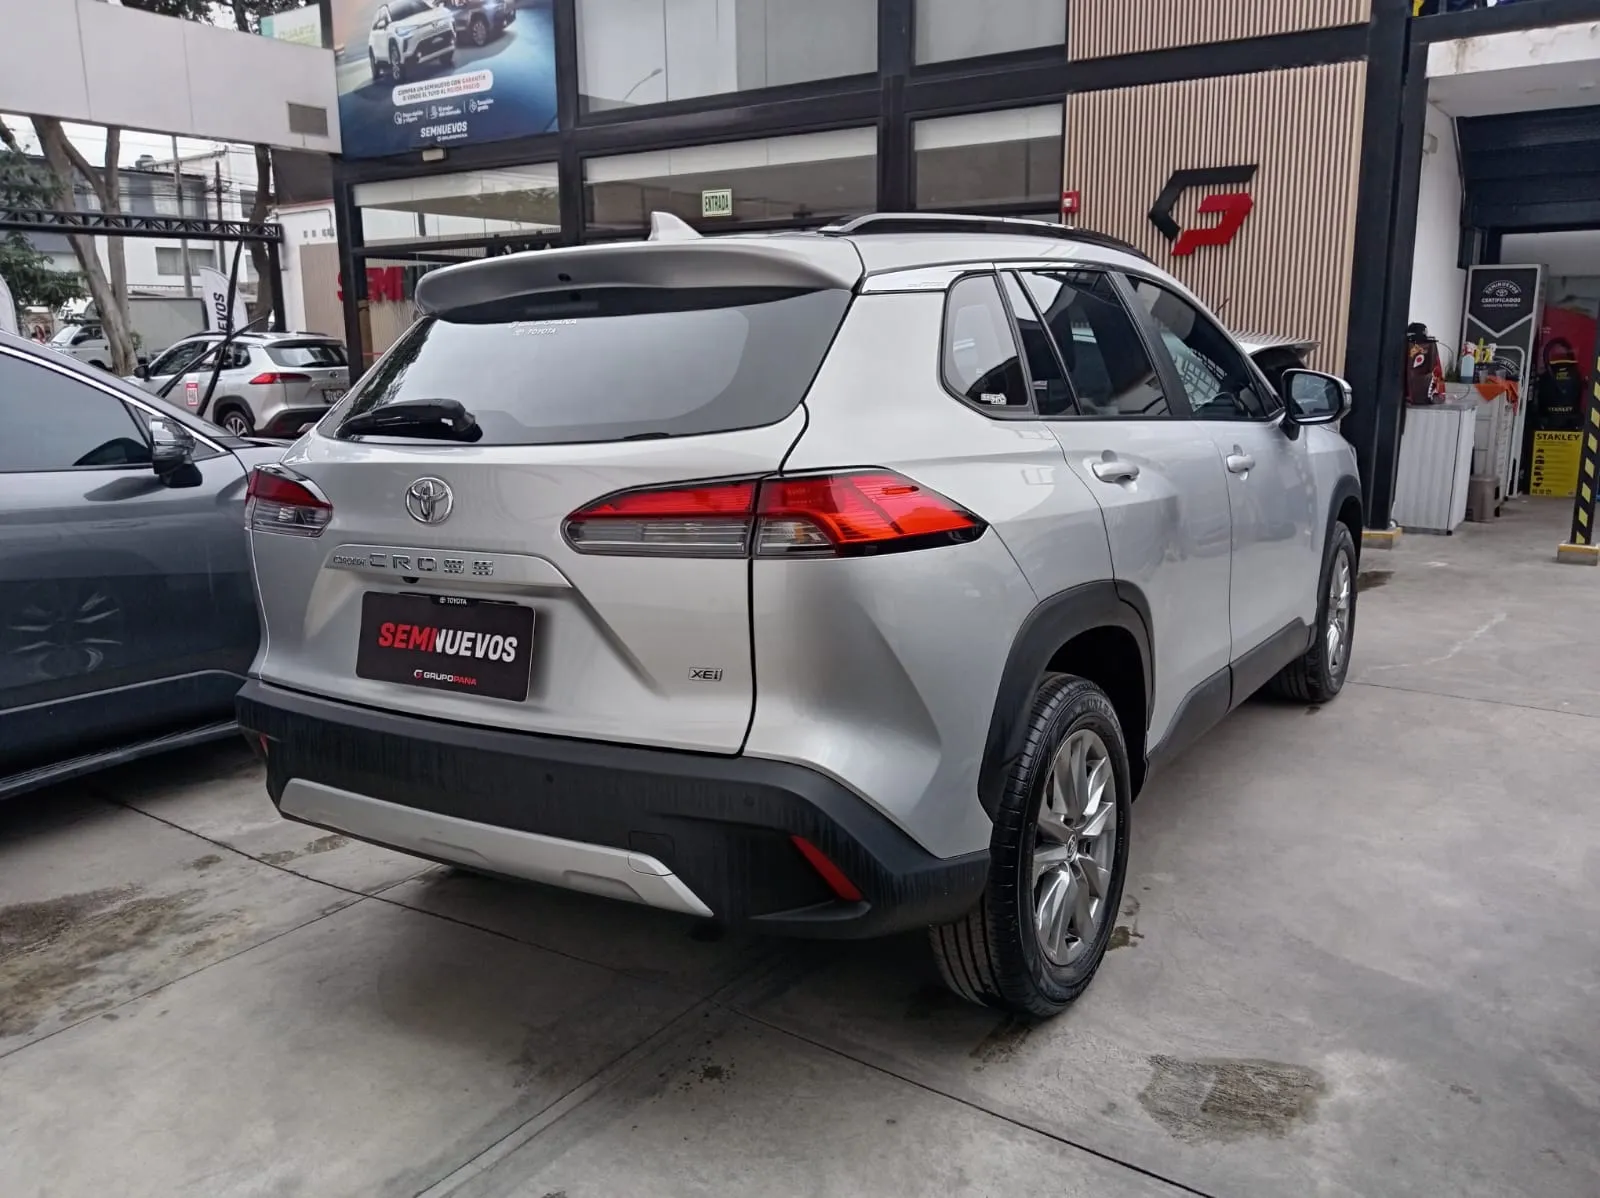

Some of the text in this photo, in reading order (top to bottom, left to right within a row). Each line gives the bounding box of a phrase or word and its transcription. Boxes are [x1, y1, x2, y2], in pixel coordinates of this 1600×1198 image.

[704, 194, 729, 212] ENTRADA
[212, 292, 229, 332] EVOS
[1536, 432, 1581, 441] STANLEY
[369, 552, 494, 576] CROSS
[447, 597, 467, 605] TOYOTA
[378, 622, 518, 663] SEMINUEVOS
[423, 671, 477, 686] GRUPOPANA
